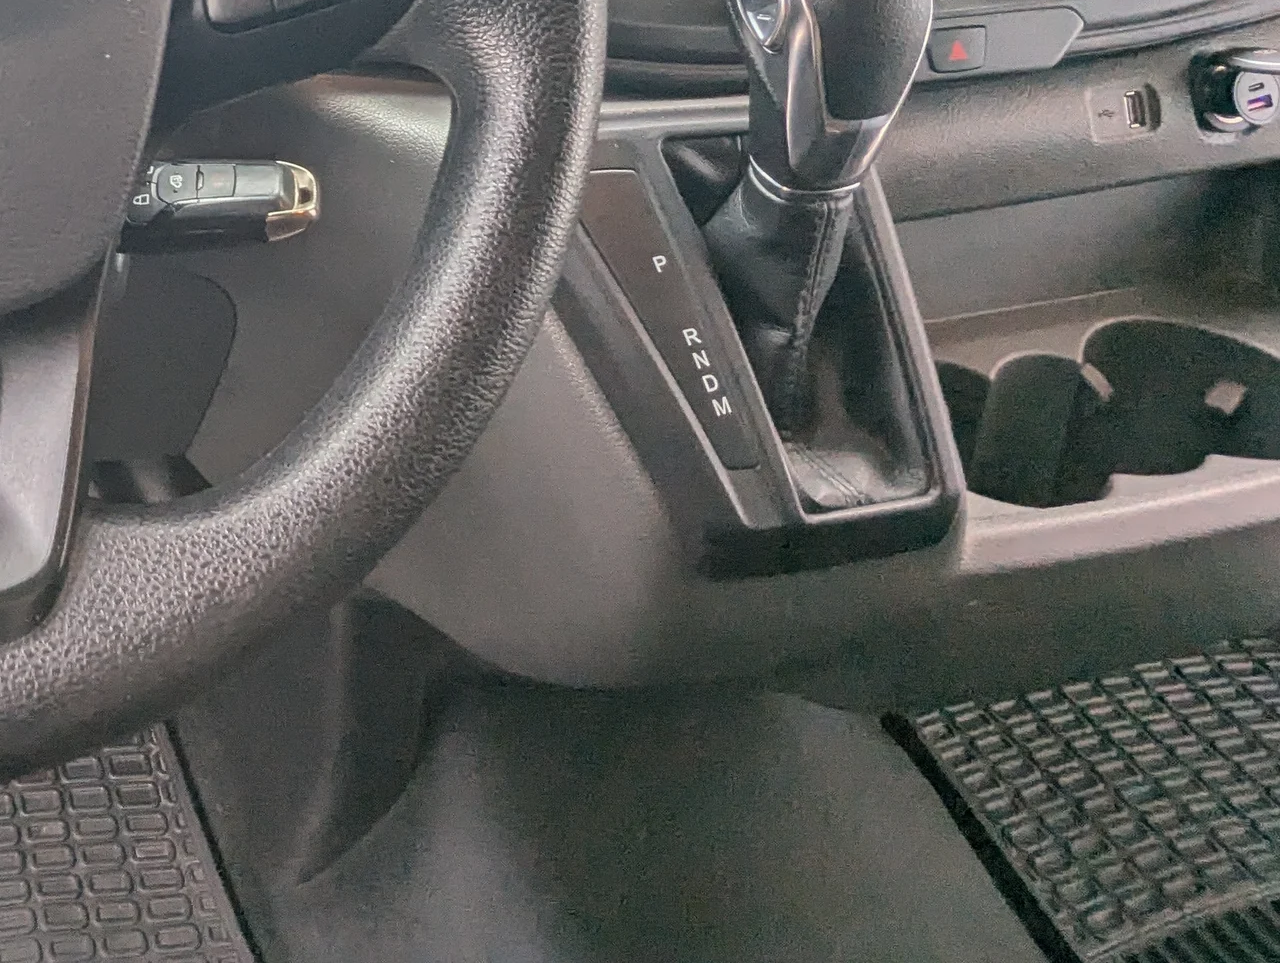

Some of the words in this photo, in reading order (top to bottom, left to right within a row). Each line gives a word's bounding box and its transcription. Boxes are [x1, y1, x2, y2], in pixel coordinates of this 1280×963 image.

[652, 255, 667, 273] P
[683, 327, 702, 346] R
[693, 350, 710, 370] N
[702, 374, 718, 393] D
[712, 397, 732, 417] M
